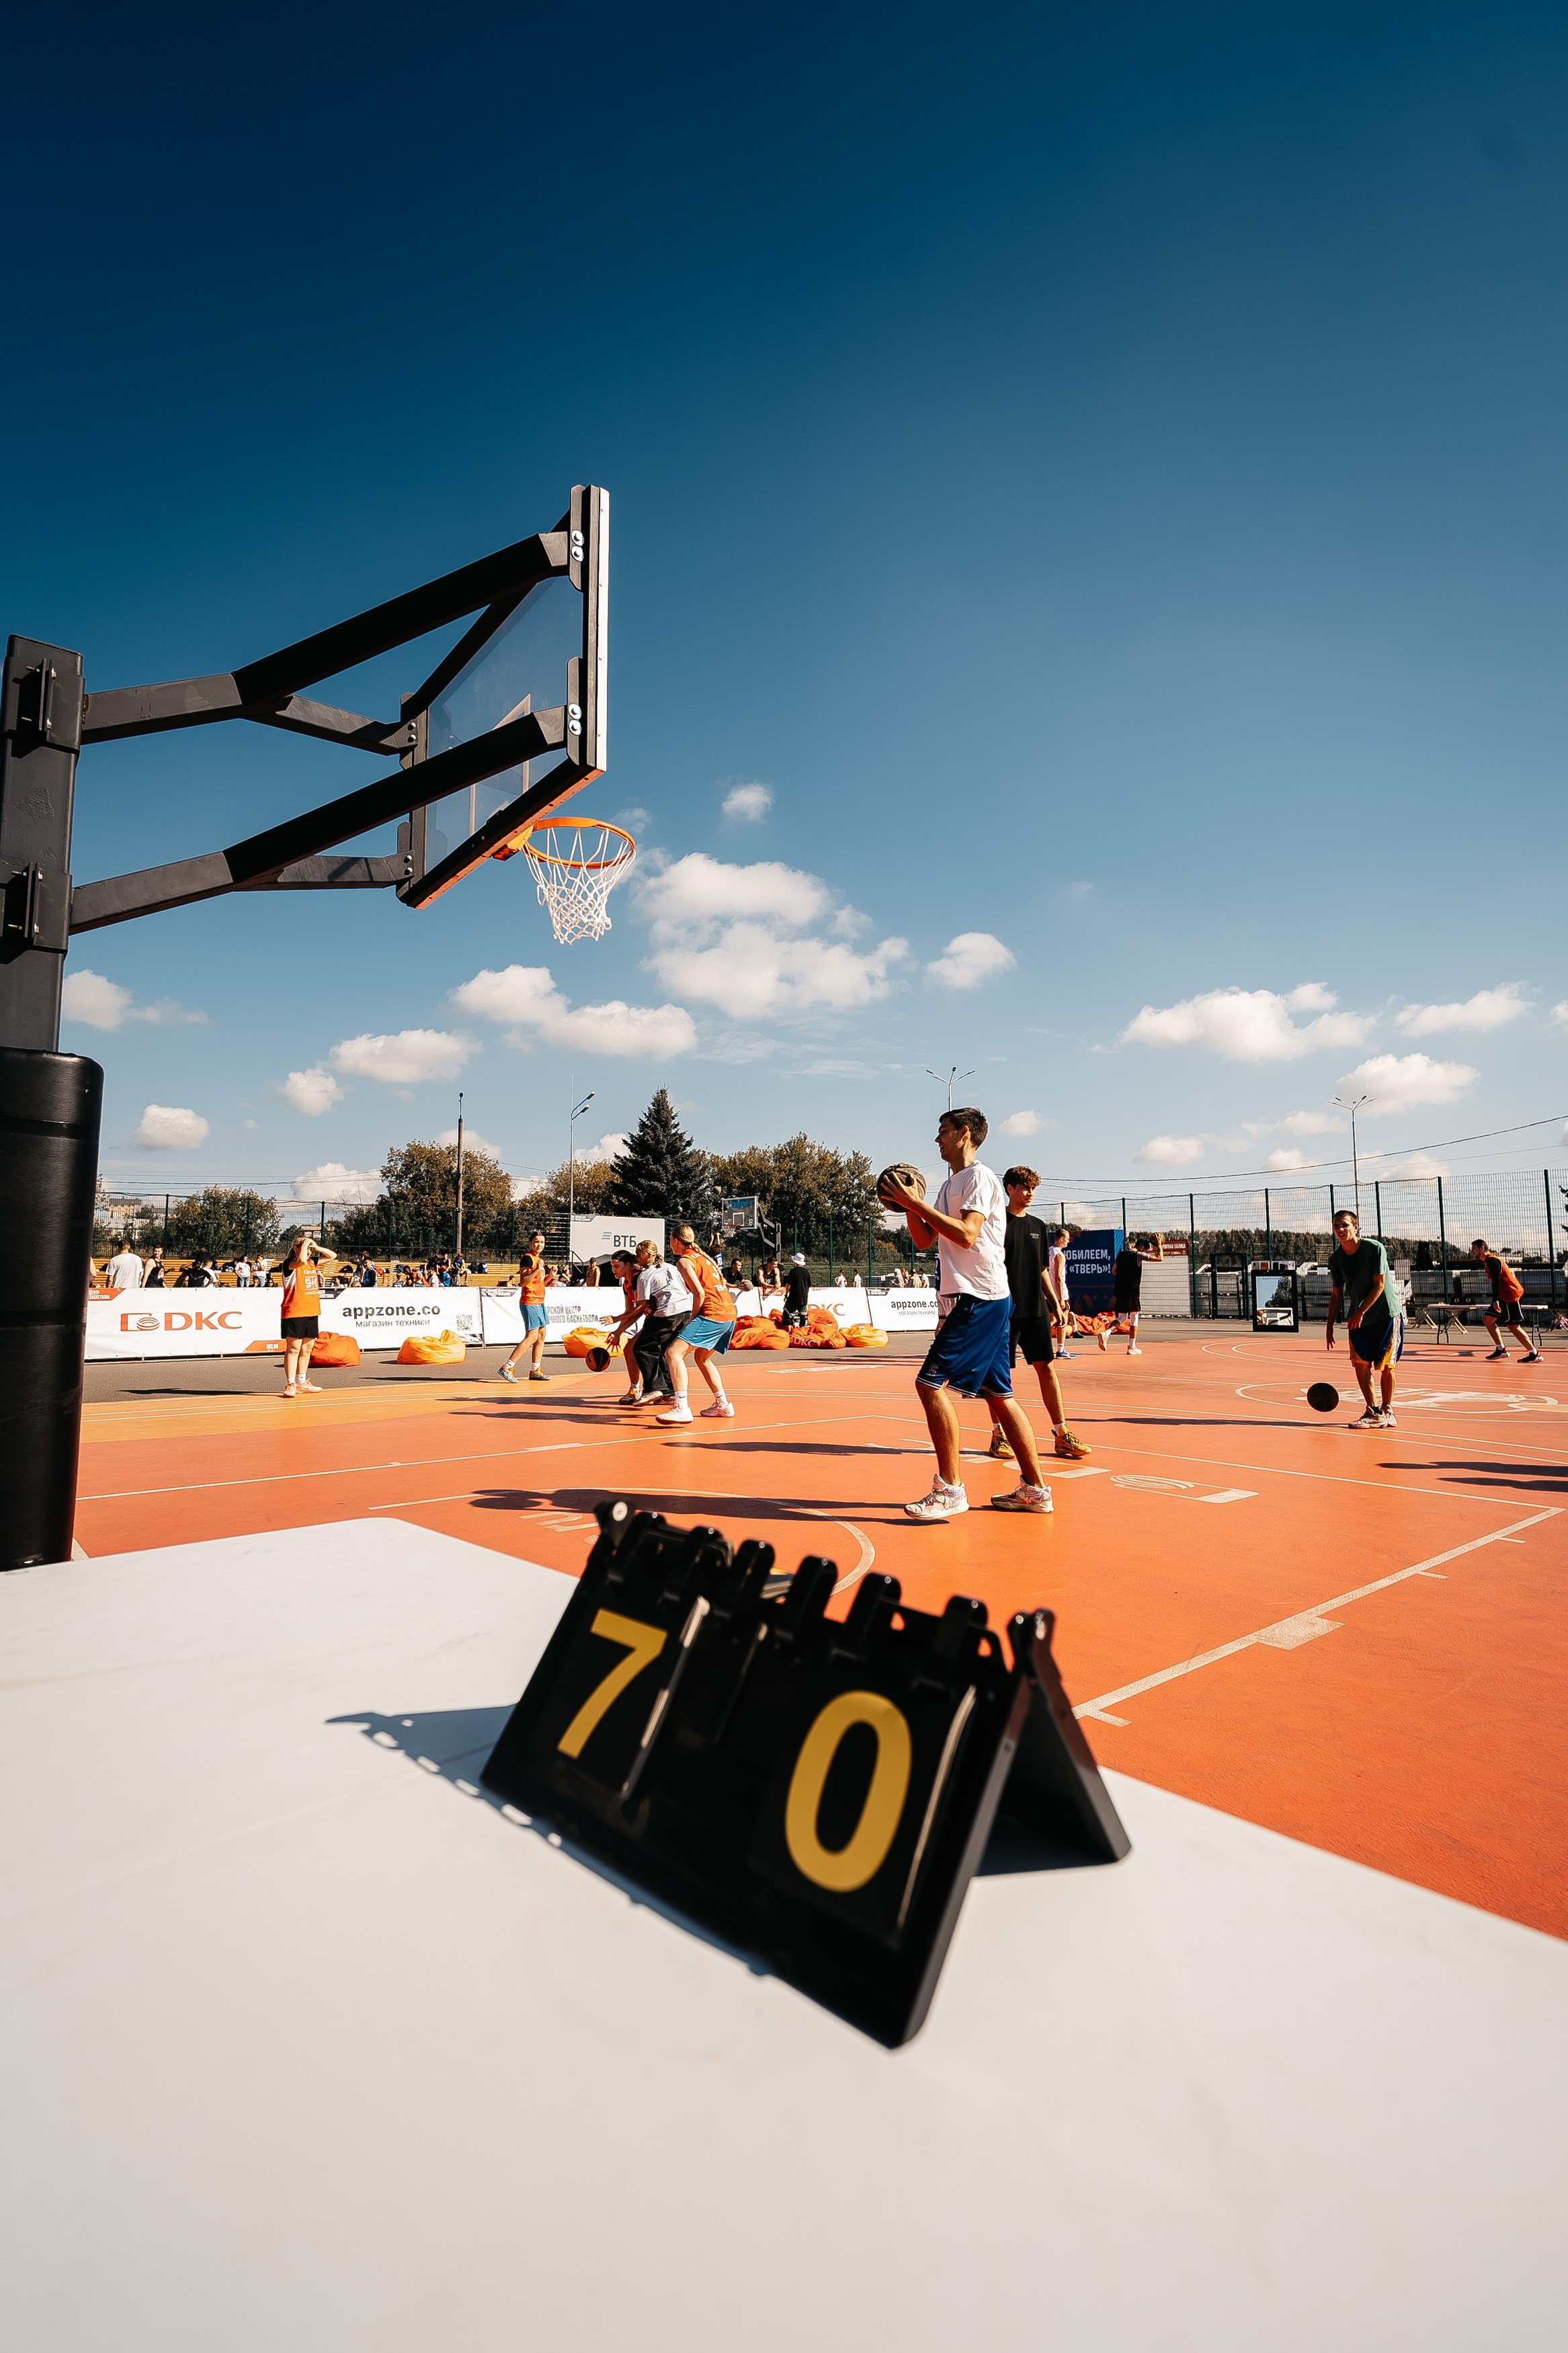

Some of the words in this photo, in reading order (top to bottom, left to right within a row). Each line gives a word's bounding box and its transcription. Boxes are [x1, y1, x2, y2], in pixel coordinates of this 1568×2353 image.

[613, 1235, 636, 1247] ВТБ
[1069, 1264, 1111, 1273] «ТВЕРЬ»!
[565, 1306, 581, 1314] ЦЕНТР
[891, 1301, 938, 1310] appzone.co
[342, 1306, 441, 1319] appzone.co
[164, 1312, 242, 1330] DKC
[567, 1315, 598, 1323] БАСКЕТБОЛА
[793, 1337, 816, 1347] DKC
[557, 1607, 668, 1759] 7
[785, 1689, 912, 1893] 0
